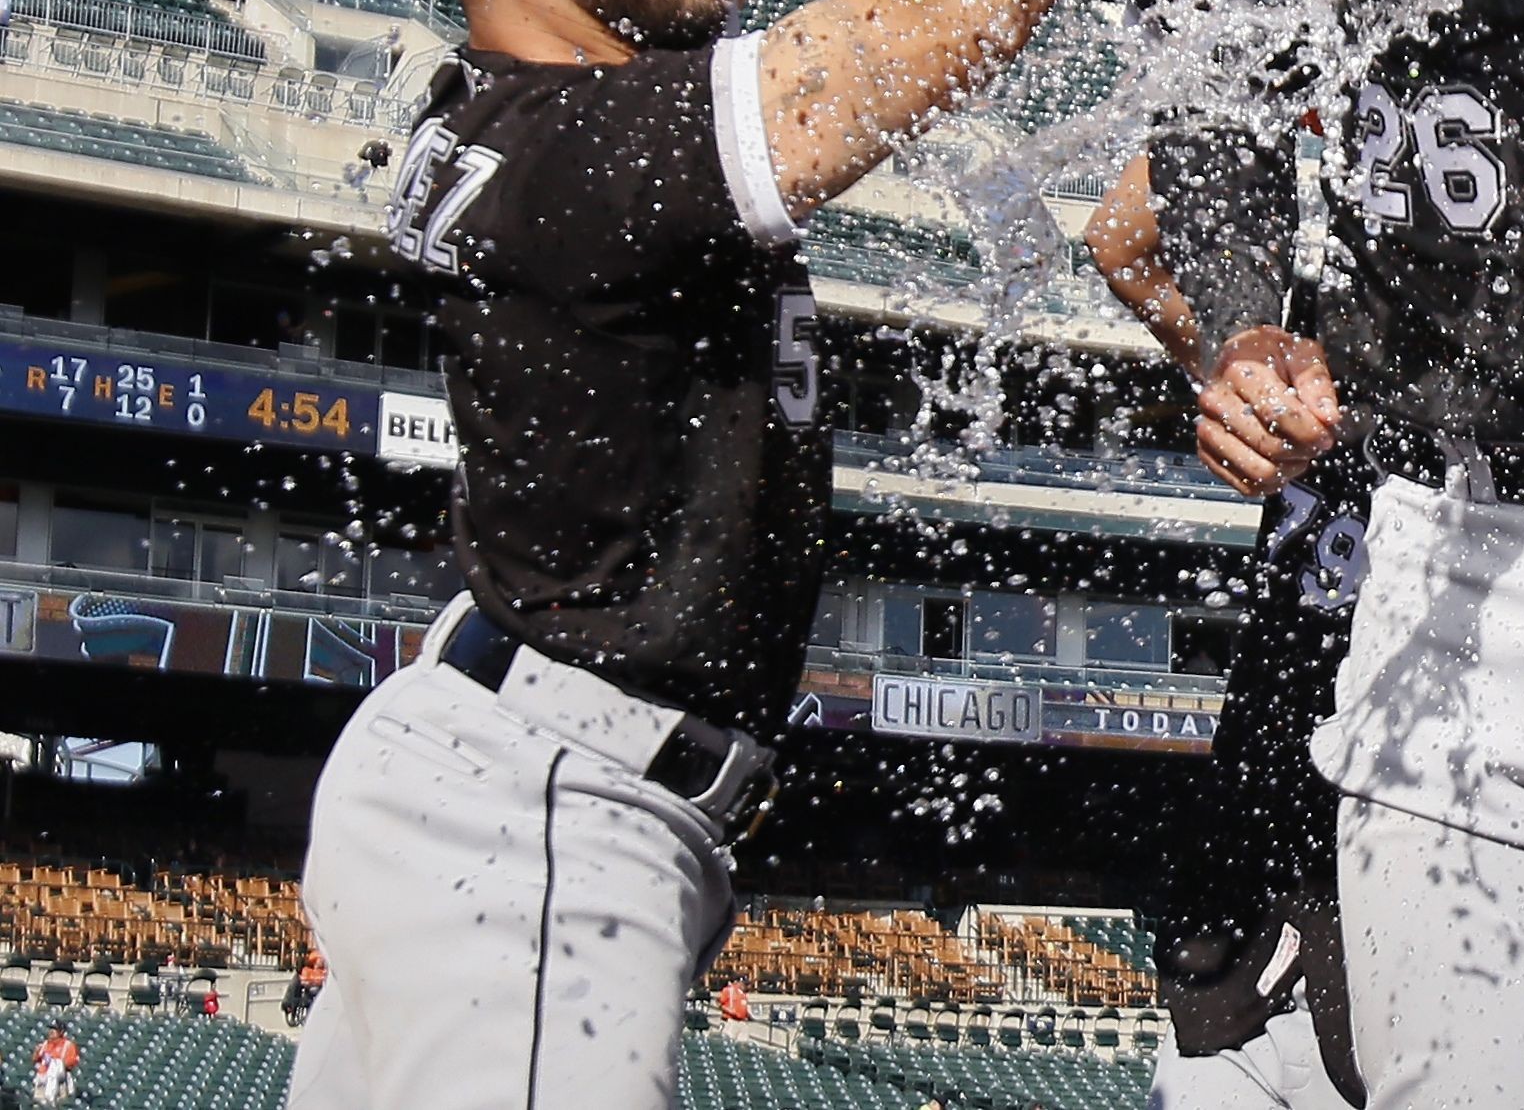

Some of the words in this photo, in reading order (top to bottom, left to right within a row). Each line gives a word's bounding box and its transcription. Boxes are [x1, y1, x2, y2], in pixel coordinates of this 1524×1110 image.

[1355, 80, 1506, 236] 26
[50, 355, 88, 382] 17
[772, 286, 820, 430] 5
[27, 365, 46, 390] R
[94, 374, 112, 399] H
[117, 364, 155, 390] 25
[188, 373, 206, 398] 1
[58, 385, 76, 410] 7
[115, 393, 152, 420] 12
[158, 383, 175, 407] E
[187, 402, 205, 426] 0
[248, 388, 350, 435] 4:54
[1267, 479, 1371, 612] 79
[882, 683, 1031, 732] CHICAGO
[1095, 708, 1220, 736] TODAY
